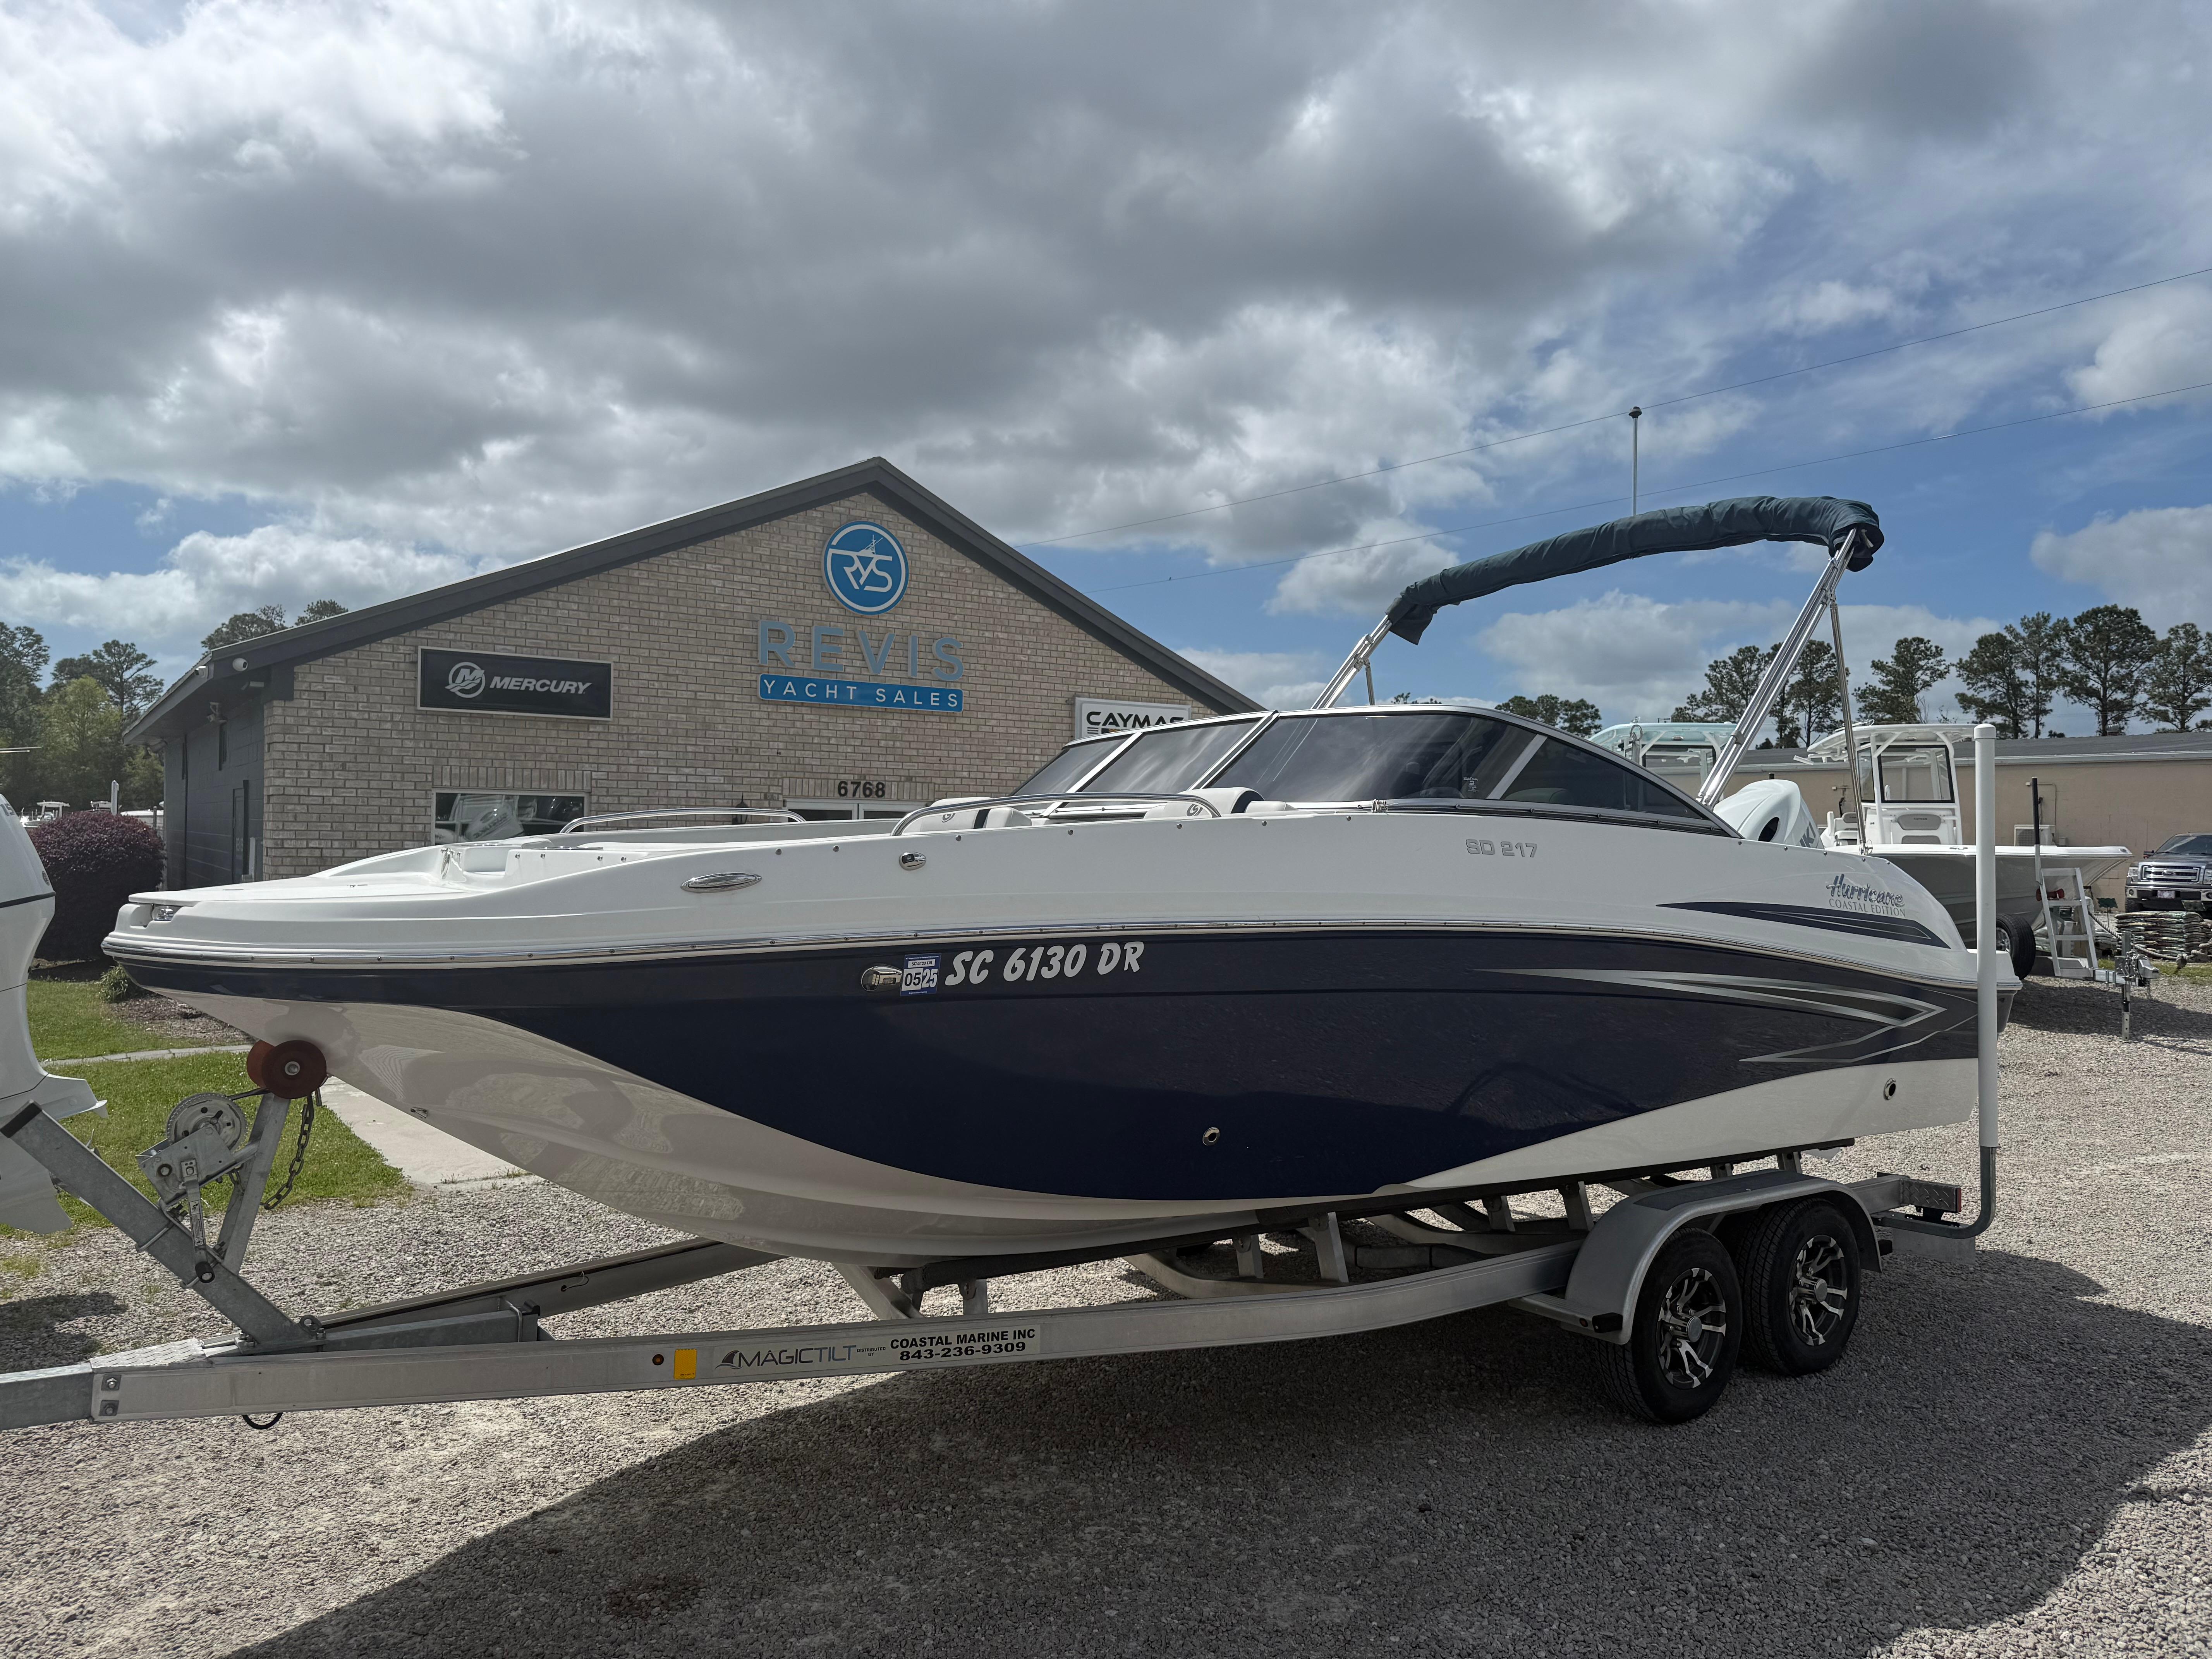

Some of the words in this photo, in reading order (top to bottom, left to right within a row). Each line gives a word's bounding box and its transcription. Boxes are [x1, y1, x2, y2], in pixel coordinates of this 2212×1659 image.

[757, 619, 964, 681] REVIS
[489, 677, 592, 694] MERCURY
[764, 679, 857, 700] YACHT
[876, 688, 958, 707] SALES
[838, 780, 886, 798] 6768
[1465, 839, 1495, 855] SD
[1500, 841, 1537, 858] 217
[1826, 873, 1905, 908] Hurricane
[1829, 898, 1867, 912] COASTAL
[1871, 904, 1906, 917] EDITION
[945, 949, 994, 986] SC
[1003, 944, 1087, 981] 6130
[1097, 941, 1145, 975] DR
[904, 972, 922, 987] 05
[921, 969, 938, 988] 25
[890, 1335, 952, 1349] COASTAL
[957, 1331, 1008, 1345] MARINE
[1013, 1328, 1036, 1340] INC
[738, 1345, 857, 1367] MAGICTILT
[899, 1341, 1026, 1361] 843-236-9309
